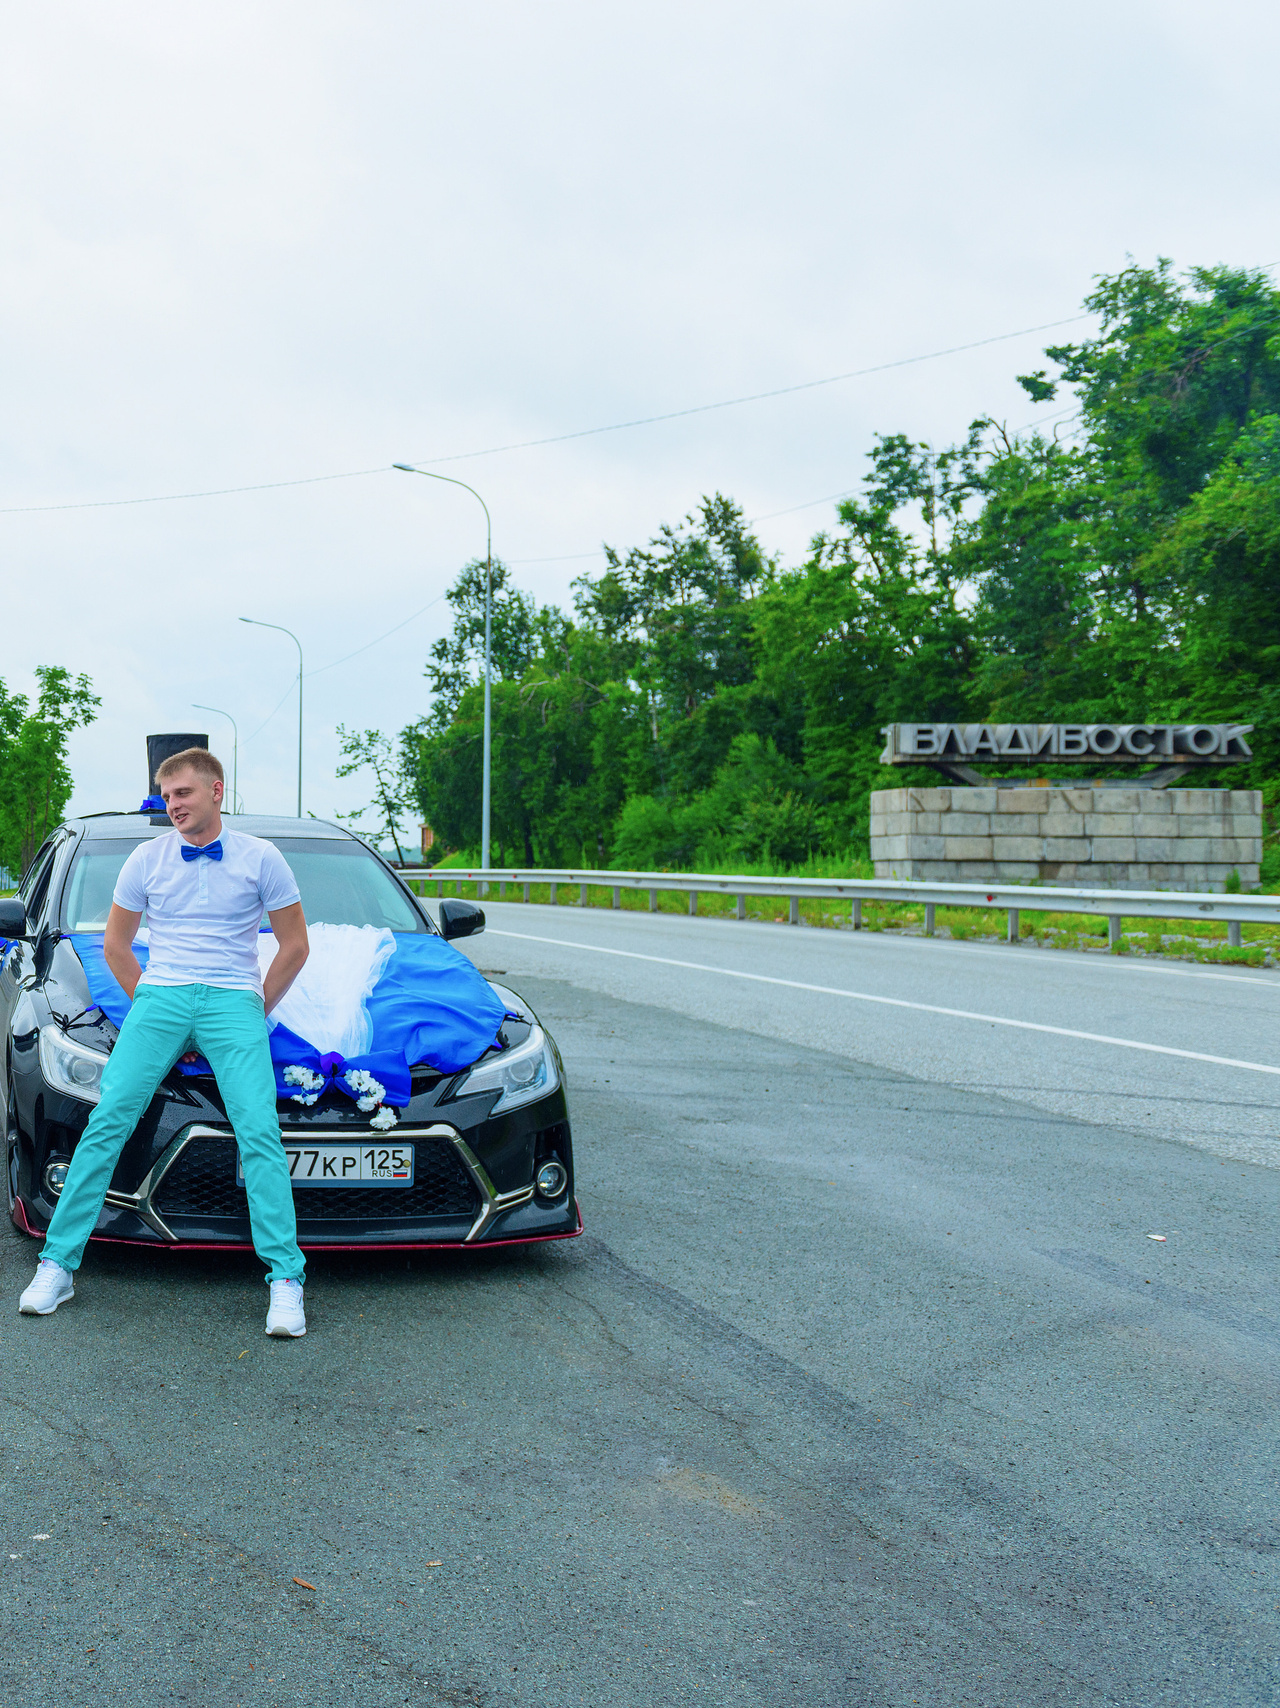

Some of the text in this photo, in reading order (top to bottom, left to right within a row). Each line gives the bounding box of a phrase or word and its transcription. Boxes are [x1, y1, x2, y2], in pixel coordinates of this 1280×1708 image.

[913, 723, 1255, 756] ВЛАДИВОСТОК
[284, 1149, 404, 1177] 77КР 125
[371, 1169, 393, 1178] RUS
